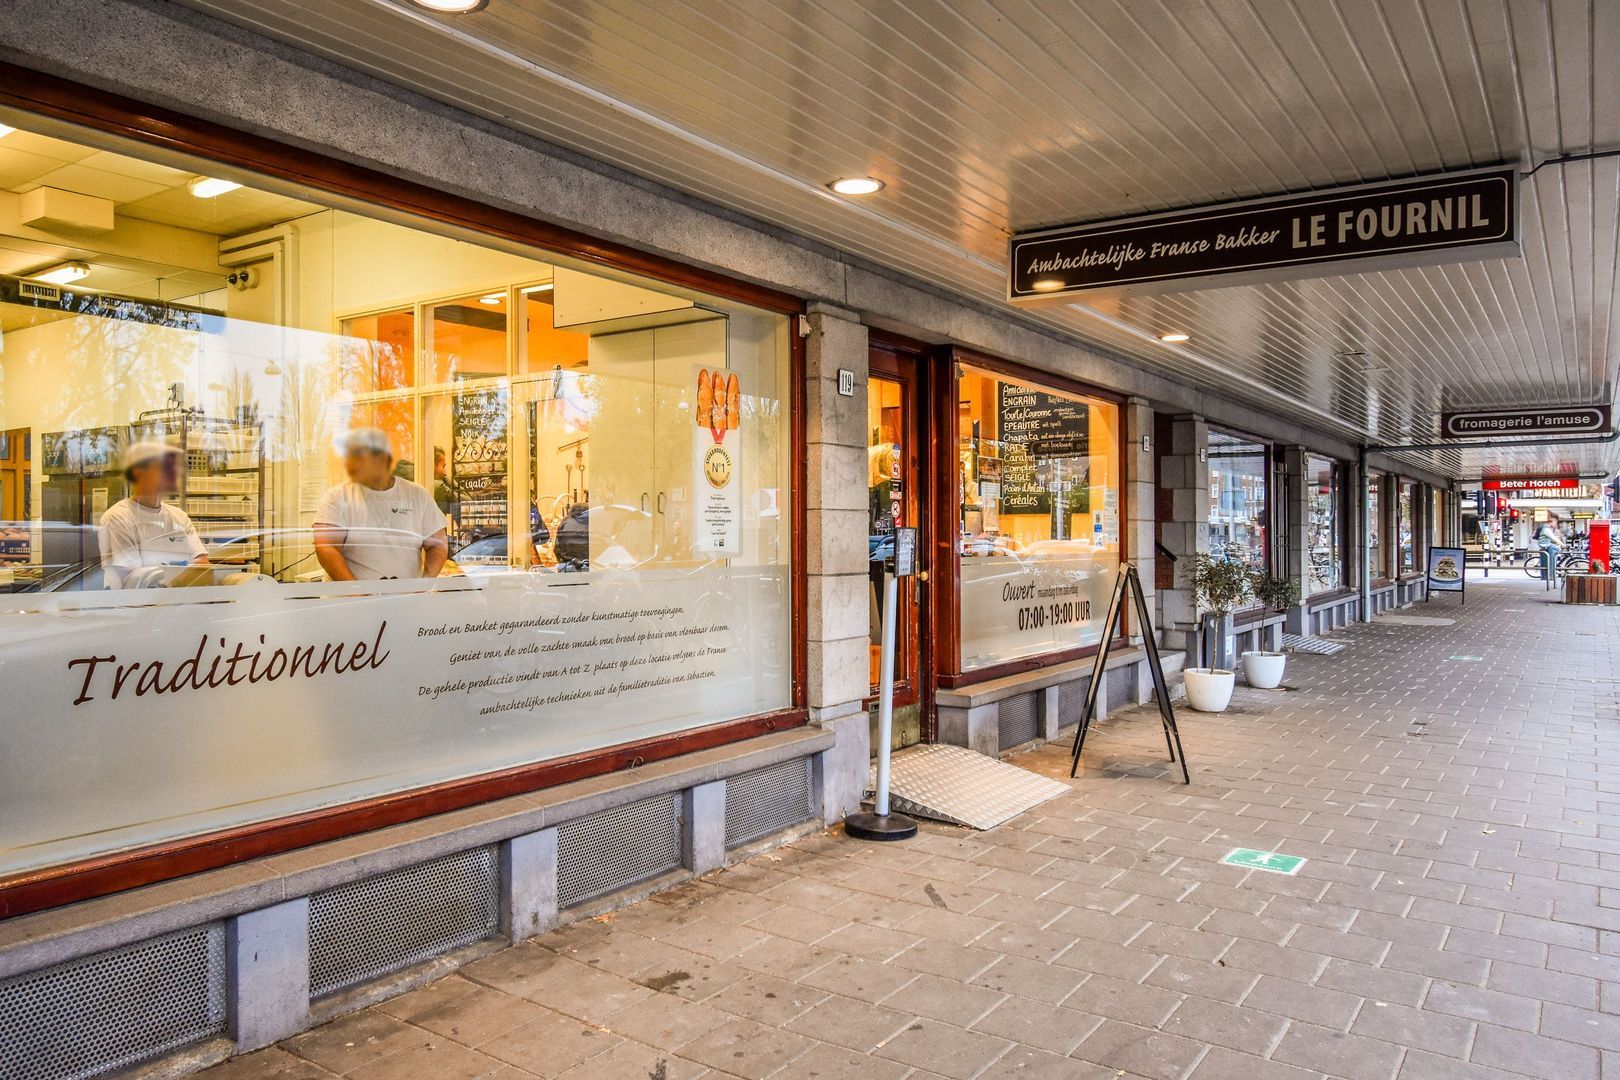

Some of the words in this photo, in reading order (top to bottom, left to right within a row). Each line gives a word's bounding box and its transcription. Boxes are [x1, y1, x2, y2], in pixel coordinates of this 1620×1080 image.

[1027, 243, 1147, 274] Ambachtelijke
[1150, 237, 1210, 259] Franse
[1215, 226, 1280, 251] Bakker
[1292, 214, 1326, 249] LE
[1338, 194, 1489, 244] FOURNIL
[841, 373, 852, 392] 119
[1003, 395, 1037, 407] ENGRAIN
[1459, 417, 1533, 429] fromagerie
[1537, 414, 1591, 426] l'amuse
[1003, 432, 1039, 443] Chapata
[1500, 480, 1527, 488] Beter
[1002, 580, 1036, 602] Ouvert
[1075, 600, 1091, 622] UUR
[417, 624, 447, 637] Brood
[449, 626, 462, 635] en
[464, 620, 498, 633] Banket
[498, 615, 560, 636] gegarandeerd
[561, 613, 590, 625] zonder
[591, 608, 639, 622] kunstmatige
[449, 651, 482, 665] Geniet
[483, 651, 502, 659] van
[504, 645, 516, 656] de
[517, 643, 539, 655] volle
[541, 640, 570, 652] zachte
[571, 636, 598, 648] smaak
[599, 638, 614, 646] van
[615, 632, 636, 643] brood
[637, 634, 646, 645] op
[647, 630, 663, 640] basis
[664, 630, 677, 638] van
[679, 625, 708, 637] vloeibaar
[68, 620, 391, 706] Traditionnel
[418, 686, 432, 696] De
[432, 679, 466, 700] gehele
[467, 674, 514, 694] productie
[515, 669, 541, 682] vindt
[542, 670, 559, 679] van
[559, 668, 567, 676] A
[569, 666, 581, 675] tot
[583, 664, 591, 673] Z
[593, 660, 618, 675] plaats
[619, 661, 629, 672] op
[629, 656, 647, 667] deze
[648, 653, 671, 664] locatie
[672, 650, 696, 663] volgens
[696, 649, 706, 657] de
[706, 646, 727, 655] Franse
[479, 695, 546, 715] ambachtelijke
[546, 687, 592, 705] technieken
[593, 686, 607, 697] uit
[607, 684, 618, 694] de
[617, 675, 671, 697] familietraditie
[672, 675, 685, 683] van
